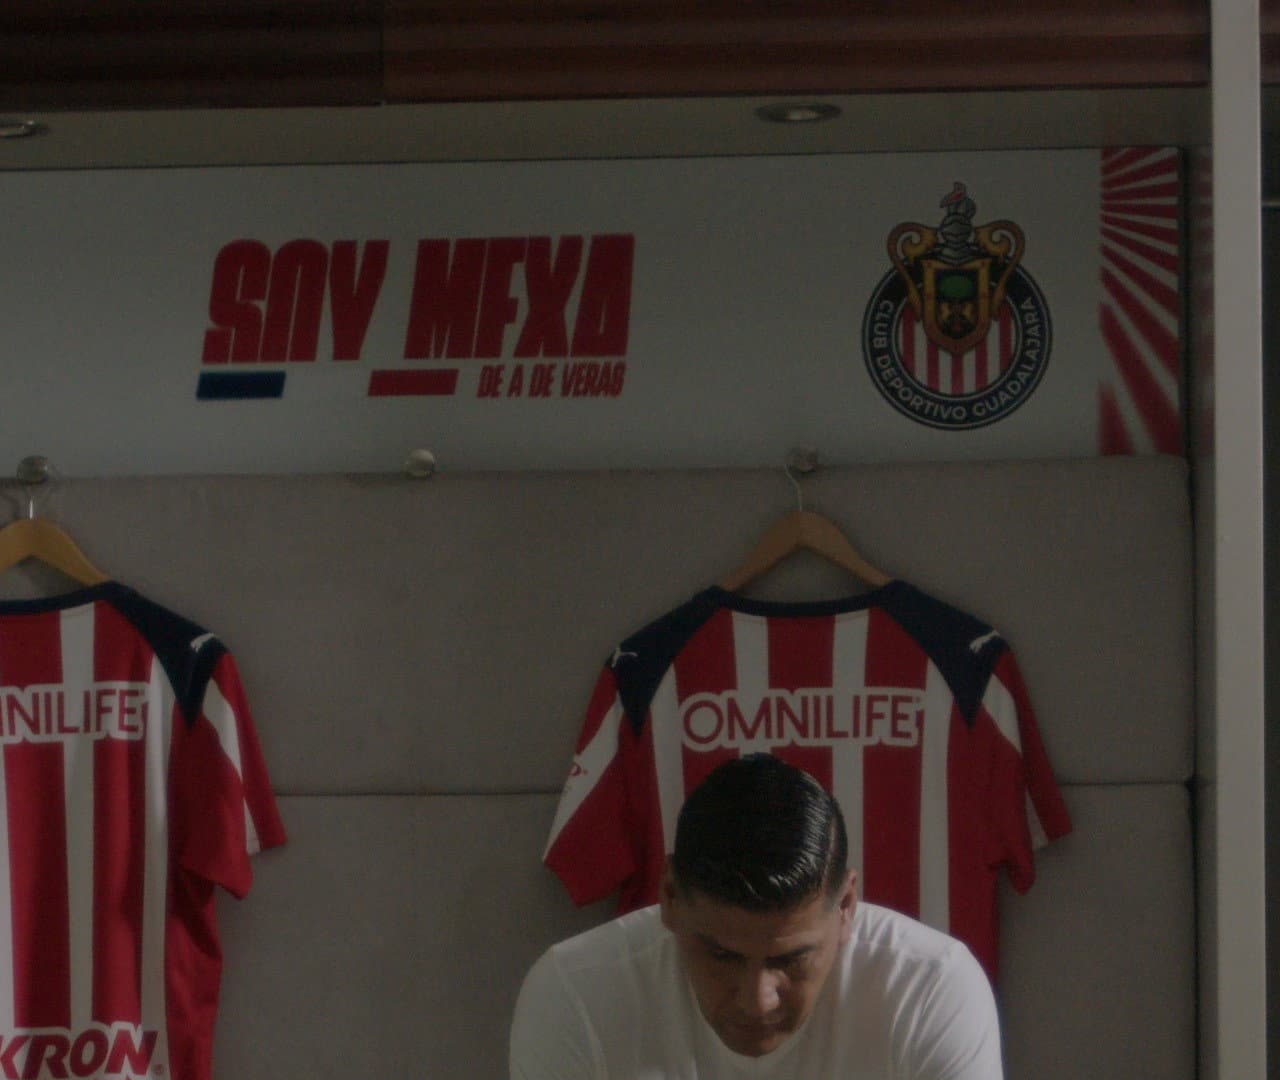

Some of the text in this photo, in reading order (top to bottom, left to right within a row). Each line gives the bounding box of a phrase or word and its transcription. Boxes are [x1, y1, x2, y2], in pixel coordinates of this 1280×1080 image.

[477, 365, 505, 397] DE
[507, 364, 524, 397] A
[529, 364, 556, 397] DE
[871, 299, 1041, 420] CLUB DEPORTIVO GUADALAJARA
[682, 694, 912, 744] OMNILIFE
